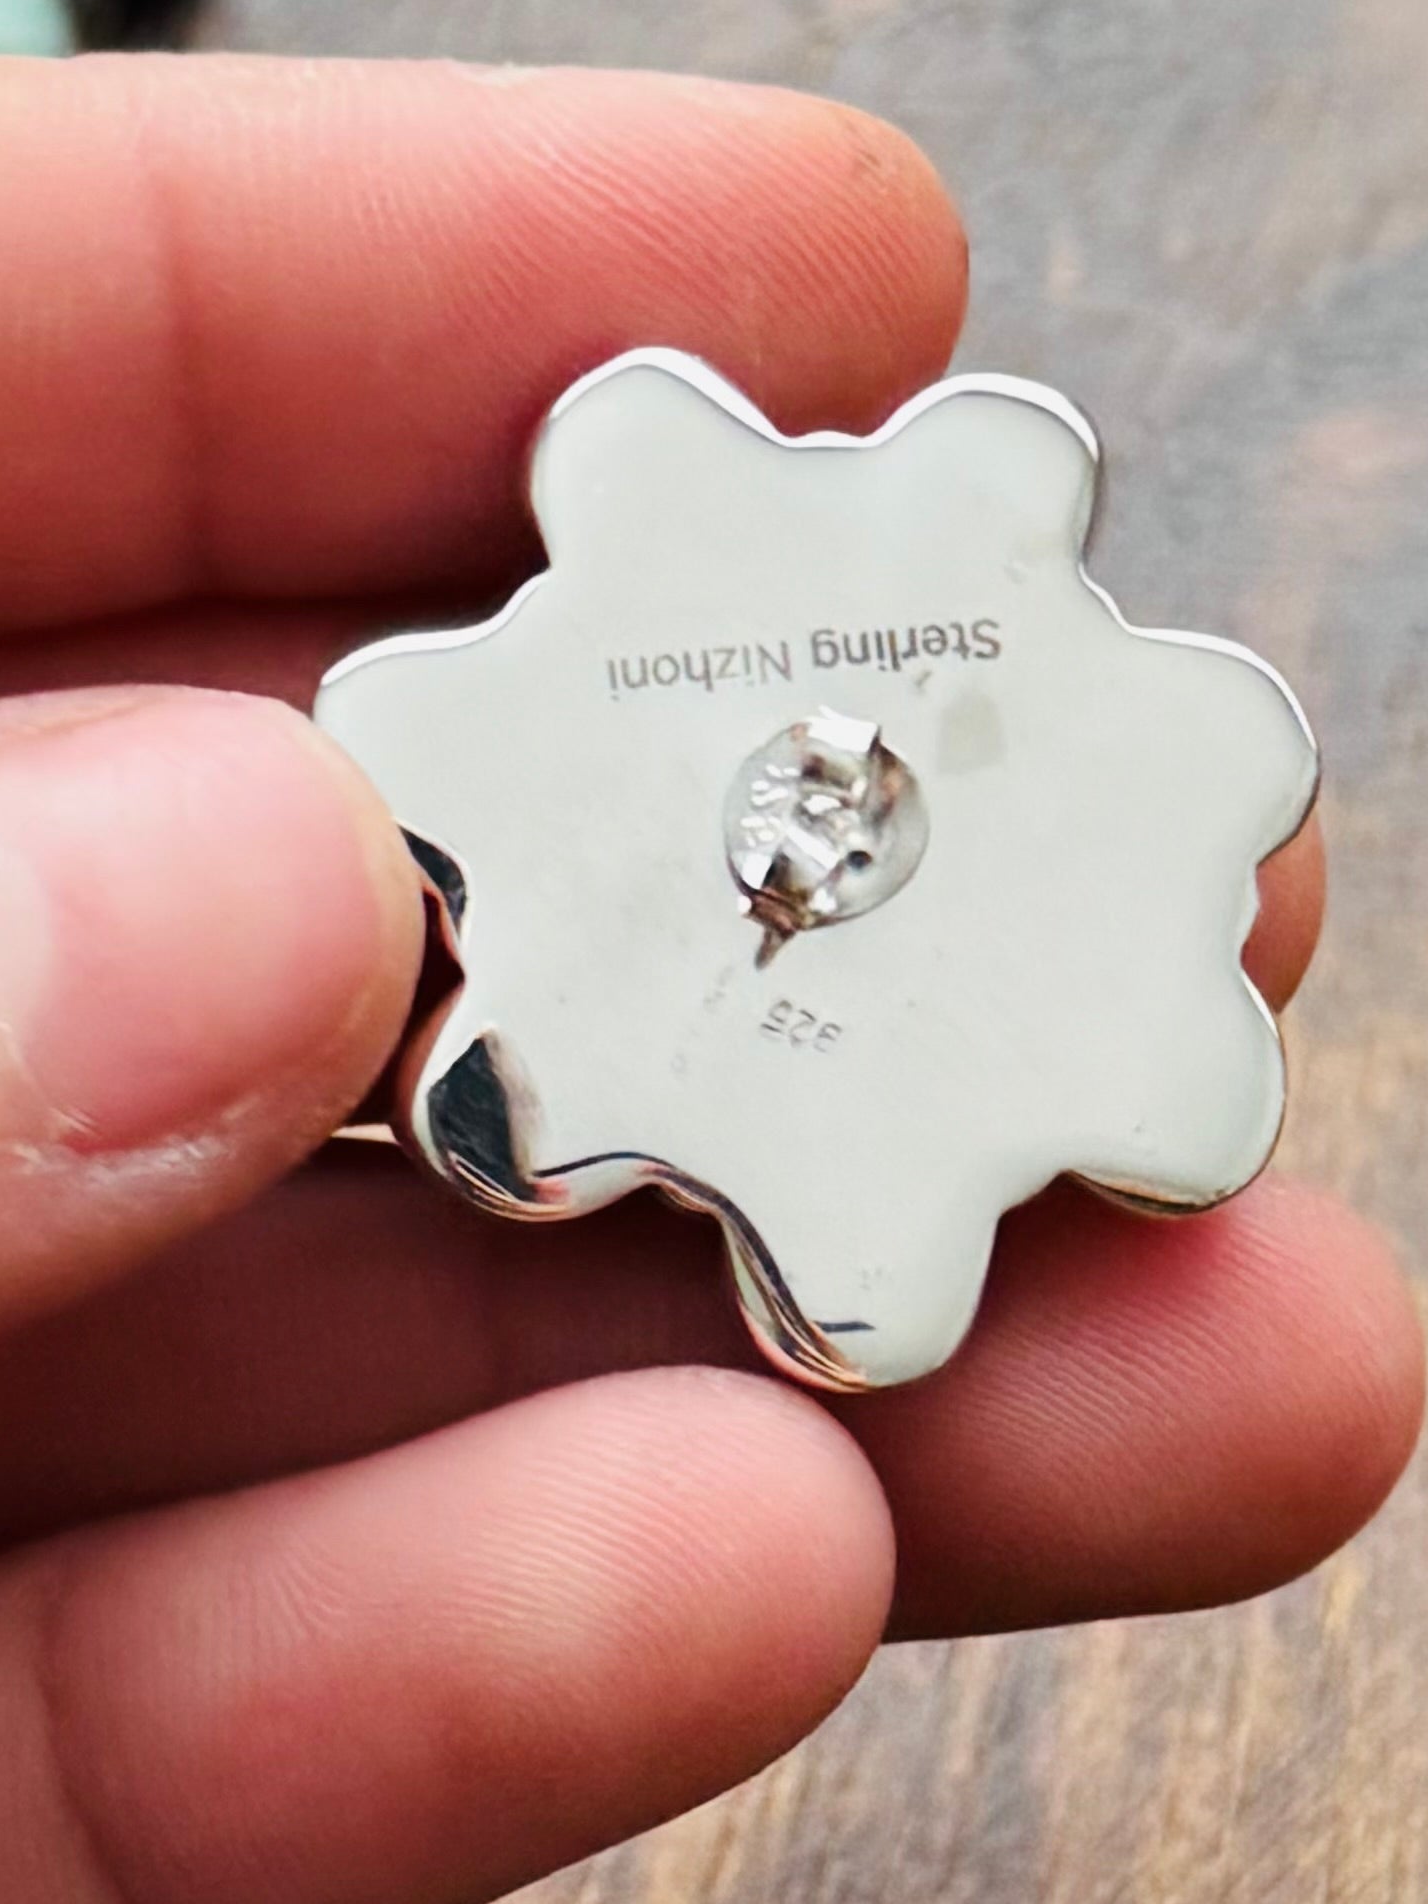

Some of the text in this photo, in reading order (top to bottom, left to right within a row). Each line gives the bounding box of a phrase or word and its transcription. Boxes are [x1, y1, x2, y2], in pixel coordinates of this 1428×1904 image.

[606, 618, 1002, 701] Sterling Nizhoni
[760, 999, 843, 1053] 925
